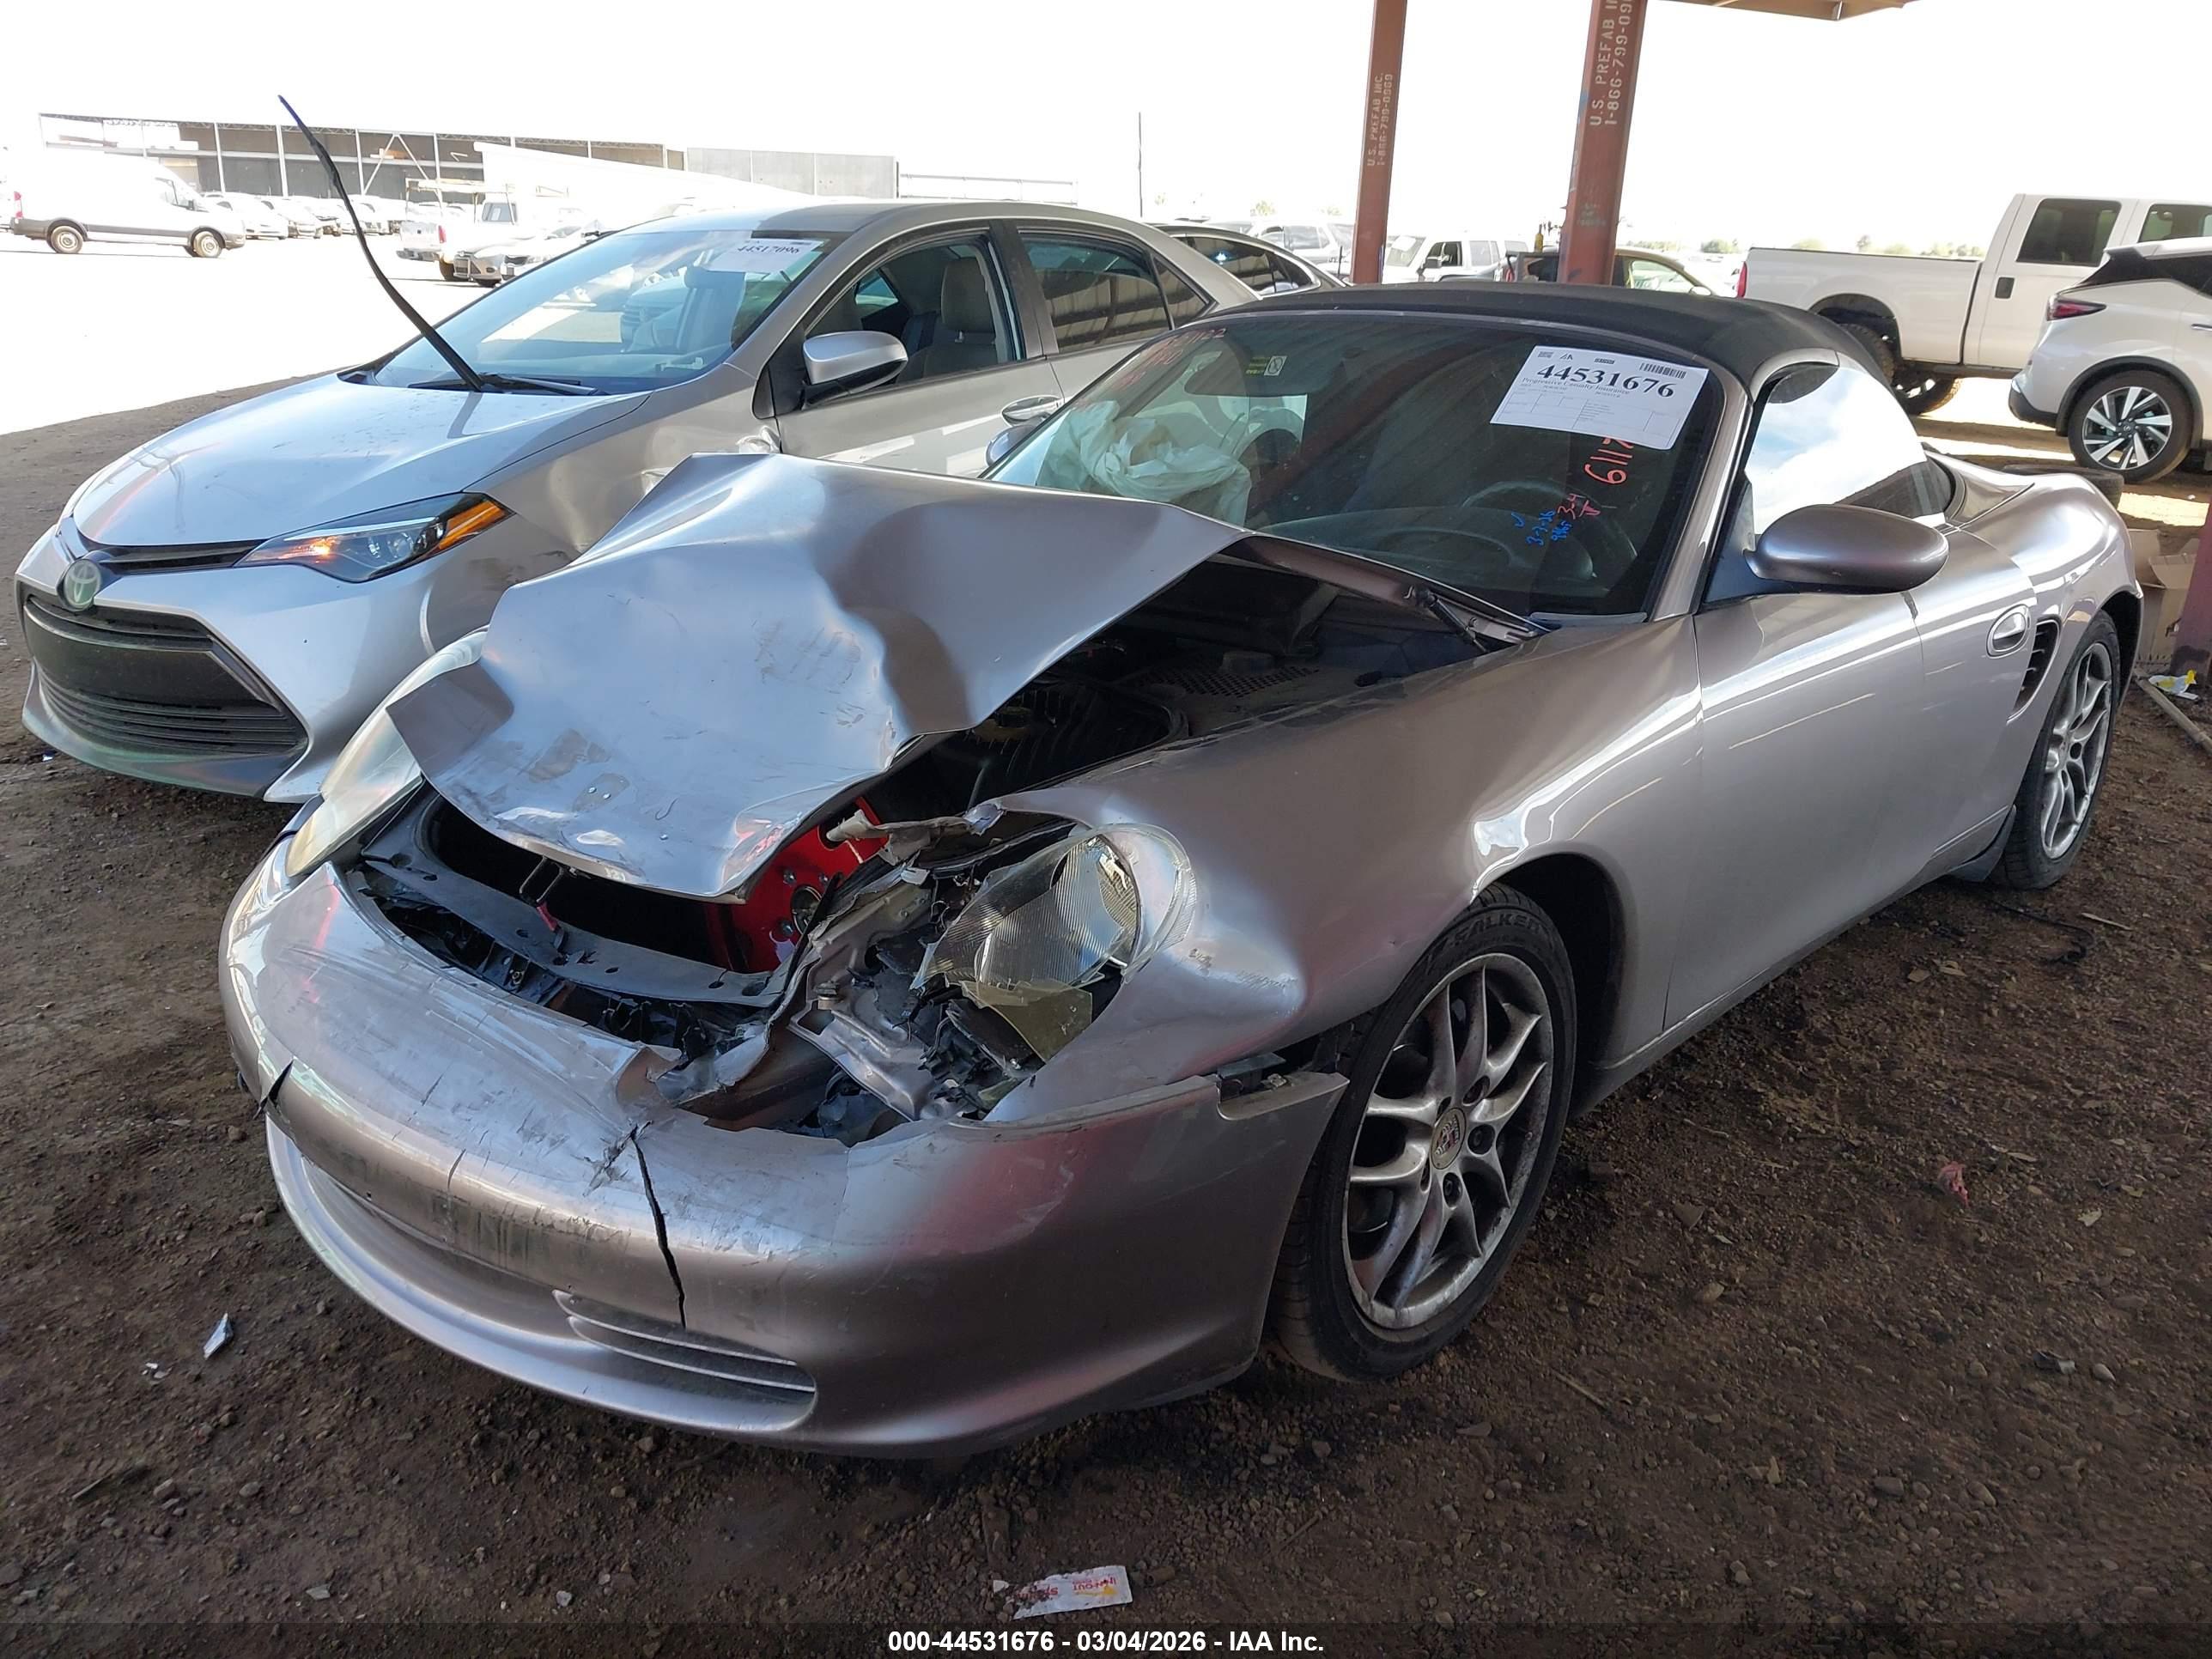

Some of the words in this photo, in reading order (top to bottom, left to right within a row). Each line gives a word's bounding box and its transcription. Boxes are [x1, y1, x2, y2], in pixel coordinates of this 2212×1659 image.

[1595, 19, 1614, 84] PREFAB
[1605, 0, 1632, 125] 1-866-799-09
[1374, 72, 1383, 93] INC.
[1370, 99, 1381, 141] PREFAB
[1367, 146, 1377, 166] U.S.
[1537, 365, 1676, 398] 44531676
